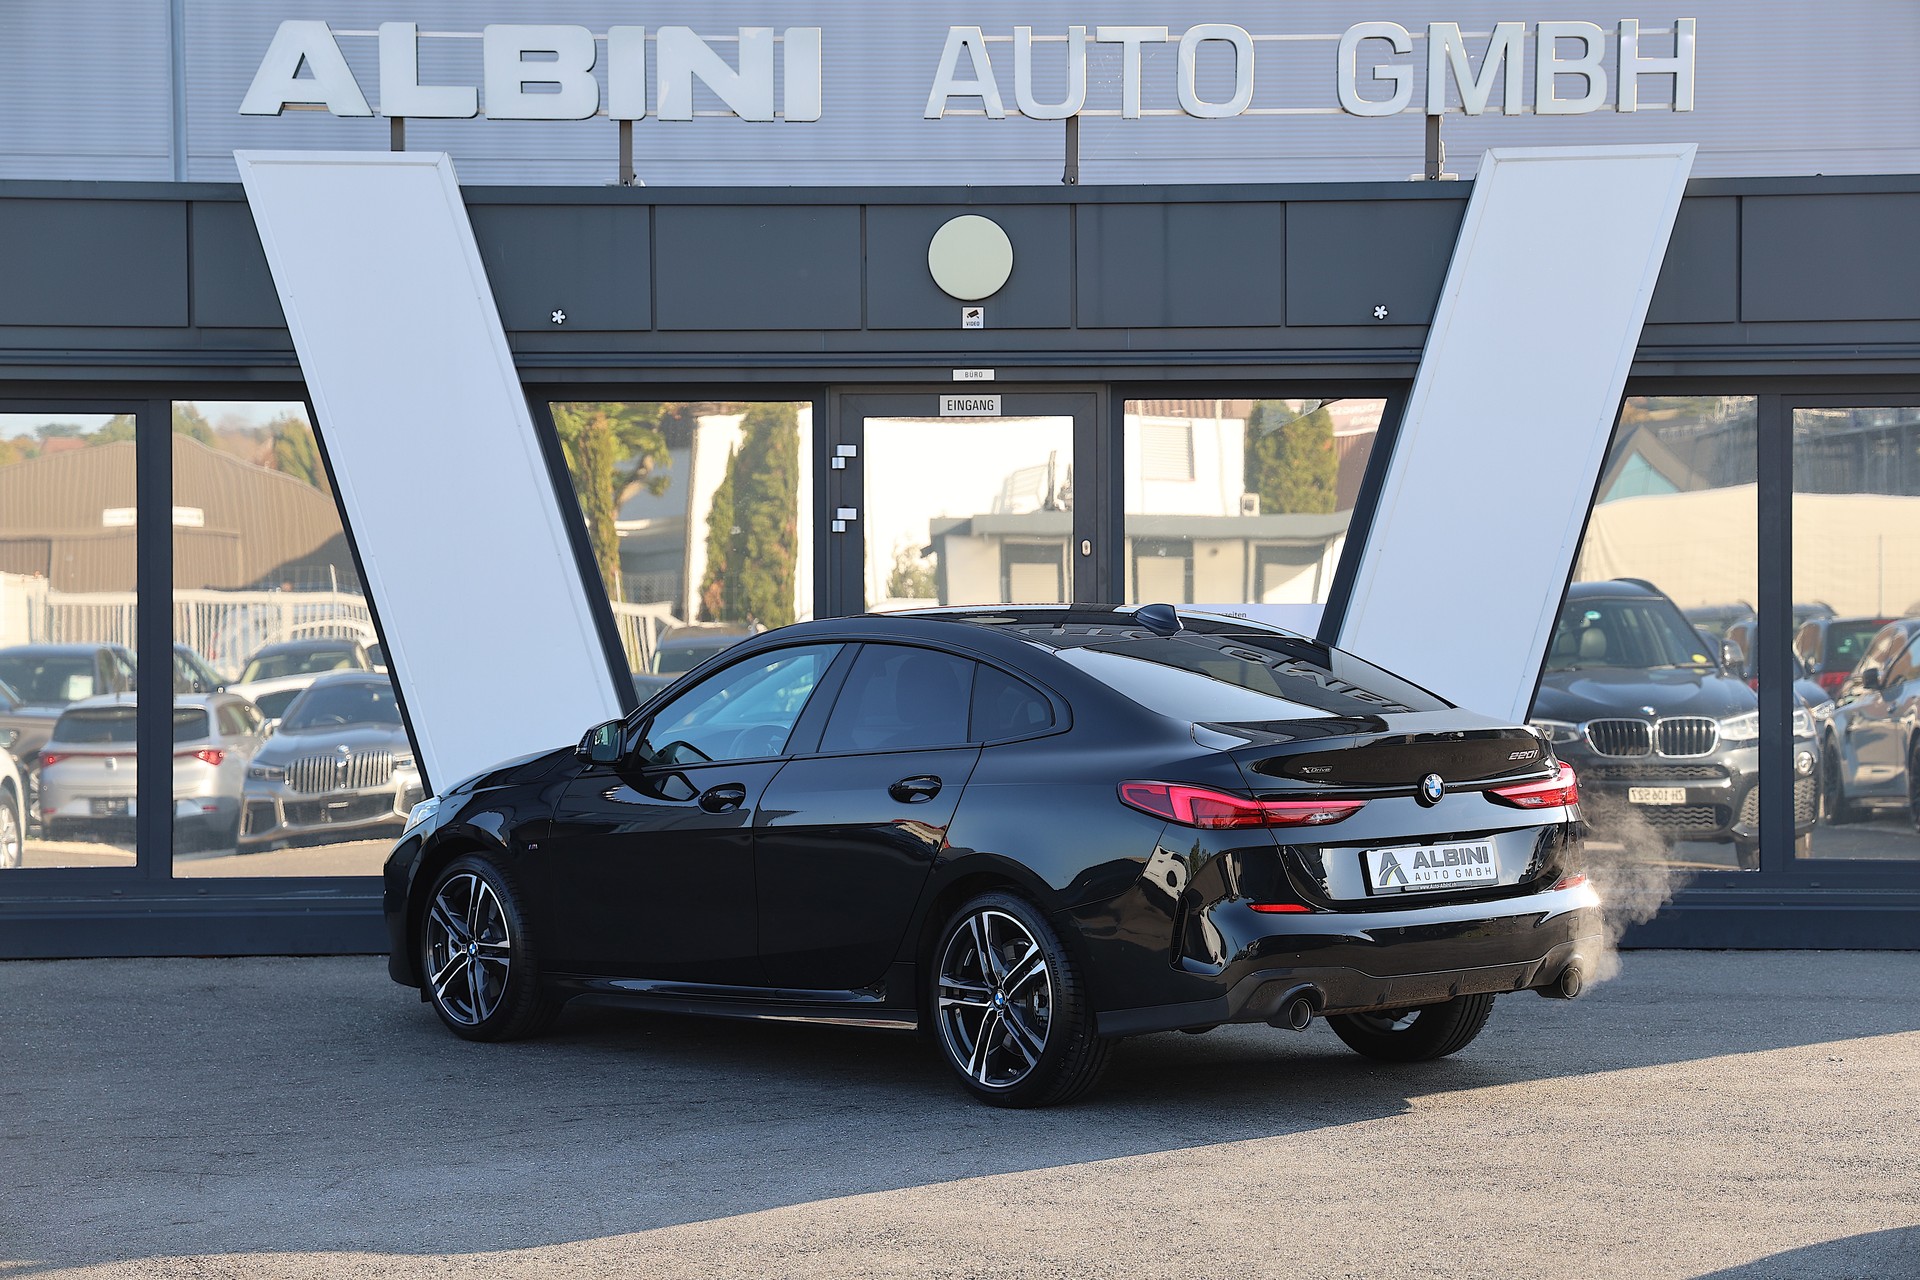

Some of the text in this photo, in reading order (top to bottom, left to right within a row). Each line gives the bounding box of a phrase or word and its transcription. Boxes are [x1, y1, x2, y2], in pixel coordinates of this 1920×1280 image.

[238, 18, 1697, 122] ALBINI AUTO GMBH
[964, 370, 983, 378] BÜRO
[947, 399, 994, 411] EINGANG
[1508, 749, 1539, 761] 220i
[1413, 846, 1490, 870] ALBINI
[1414, 866, 1492, 882] AUTO GMBH
